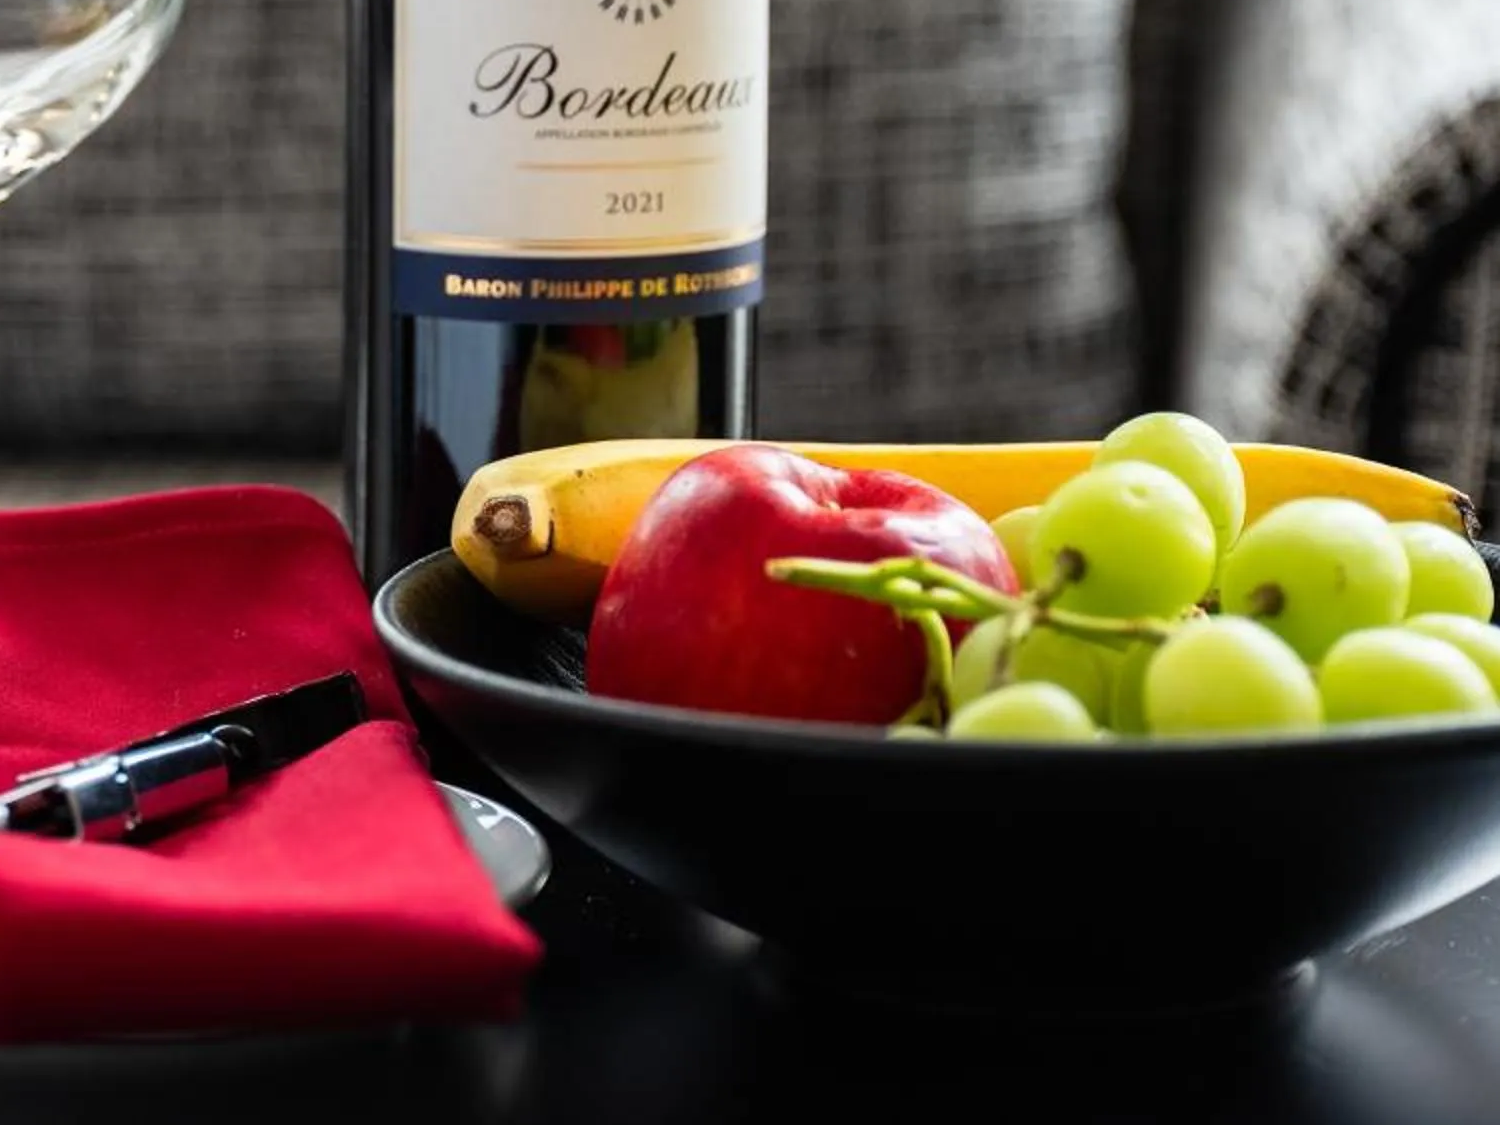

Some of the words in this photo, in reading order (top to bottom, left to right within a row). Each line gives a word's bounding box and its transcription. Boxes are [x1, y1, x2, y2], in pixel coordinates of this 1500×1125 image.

[605, 192, 664, 215] 2021
[444, 274, 522, 298] BARON
[529, 278, 634, 299] PHILIPPE
[639, 276, 668, 297] DE
